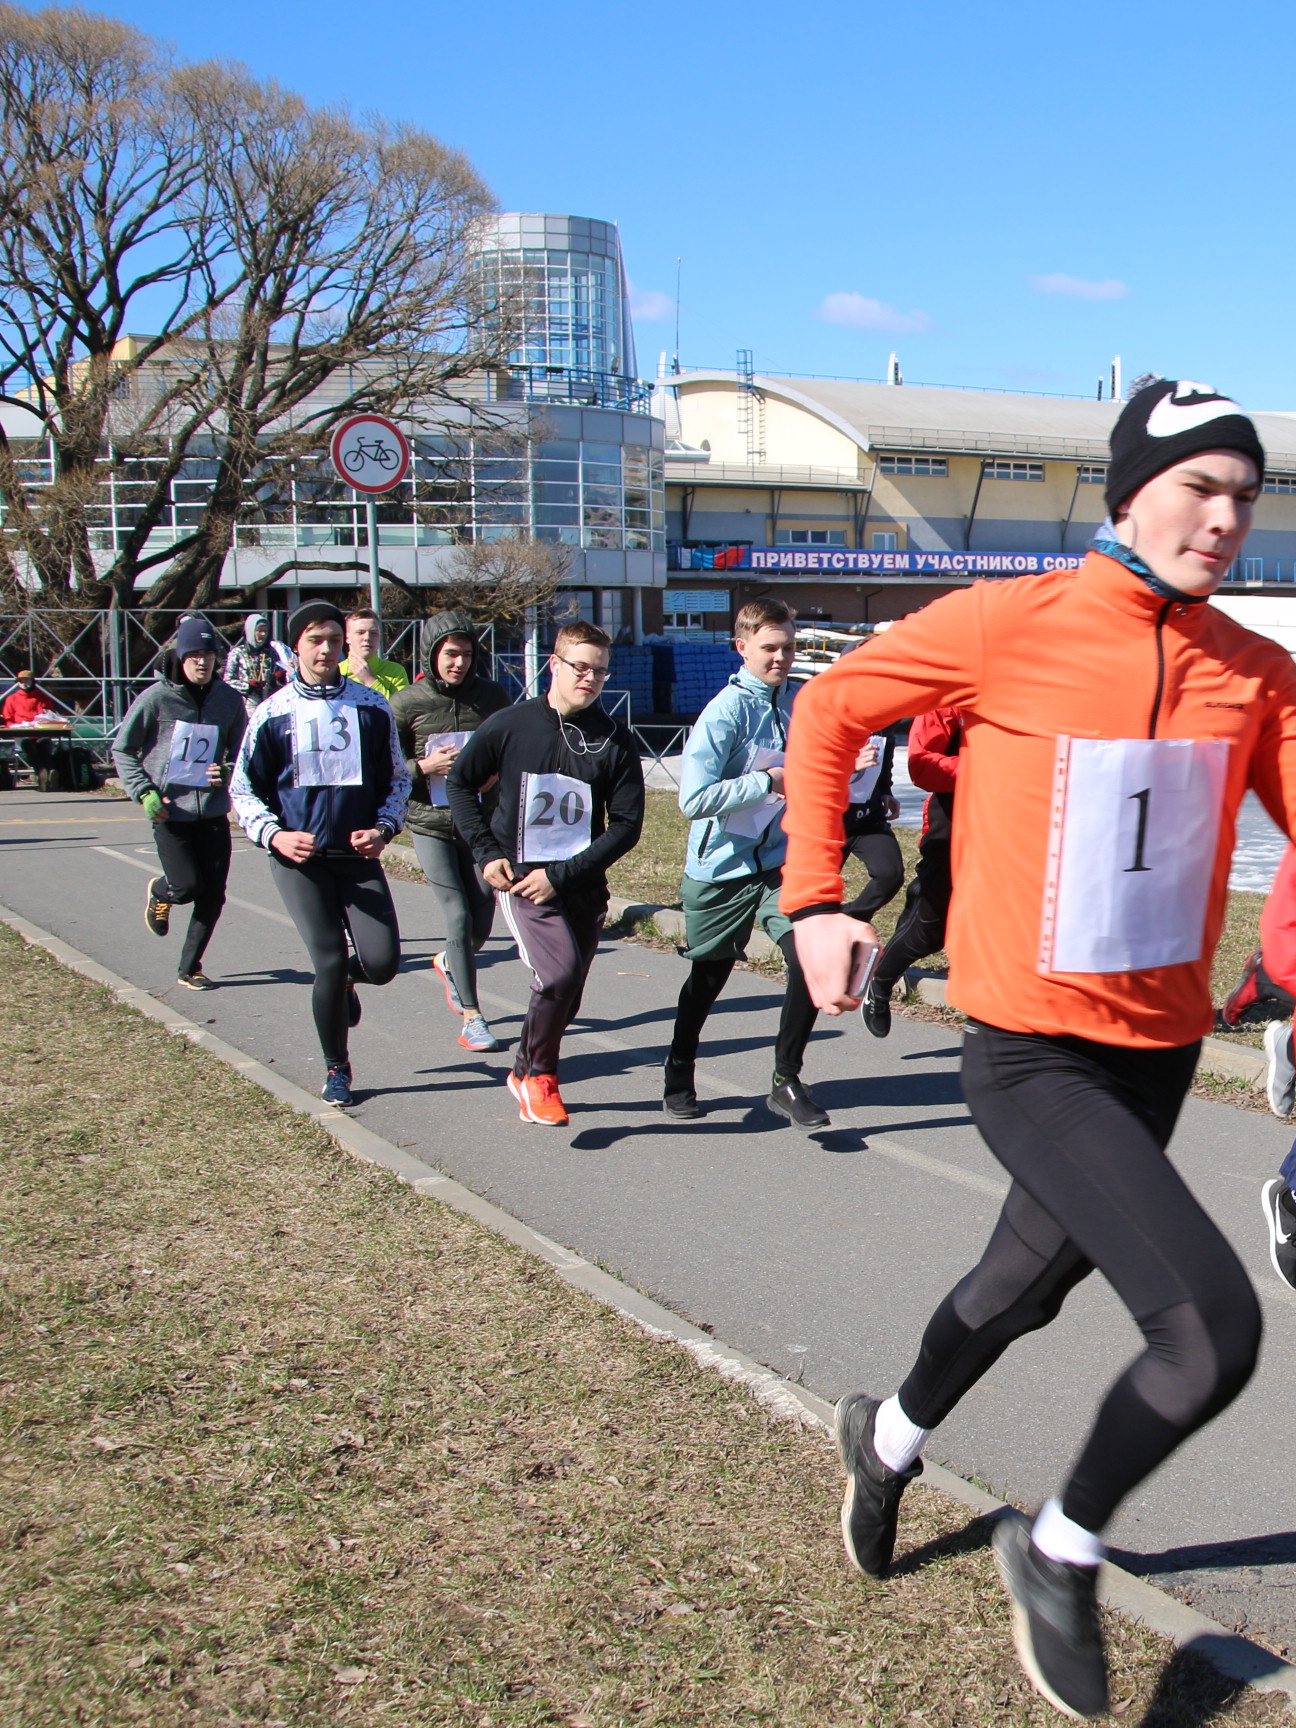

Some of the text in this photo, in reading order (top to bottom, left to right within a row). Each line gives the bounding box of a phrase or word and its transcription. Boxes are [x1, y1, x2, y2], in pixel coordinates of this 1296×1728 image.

[752, 552, 909, 568] ПРИВЕТСТВУЕМ
[915, 554, 1038, 570] УЧАСТНИКОВ
[178, 736, 210, 763] 12
[304, 716, 352, 752] 13
[530, 791, 585, 825] 20
[1122, 787, 1153, 872] 1
